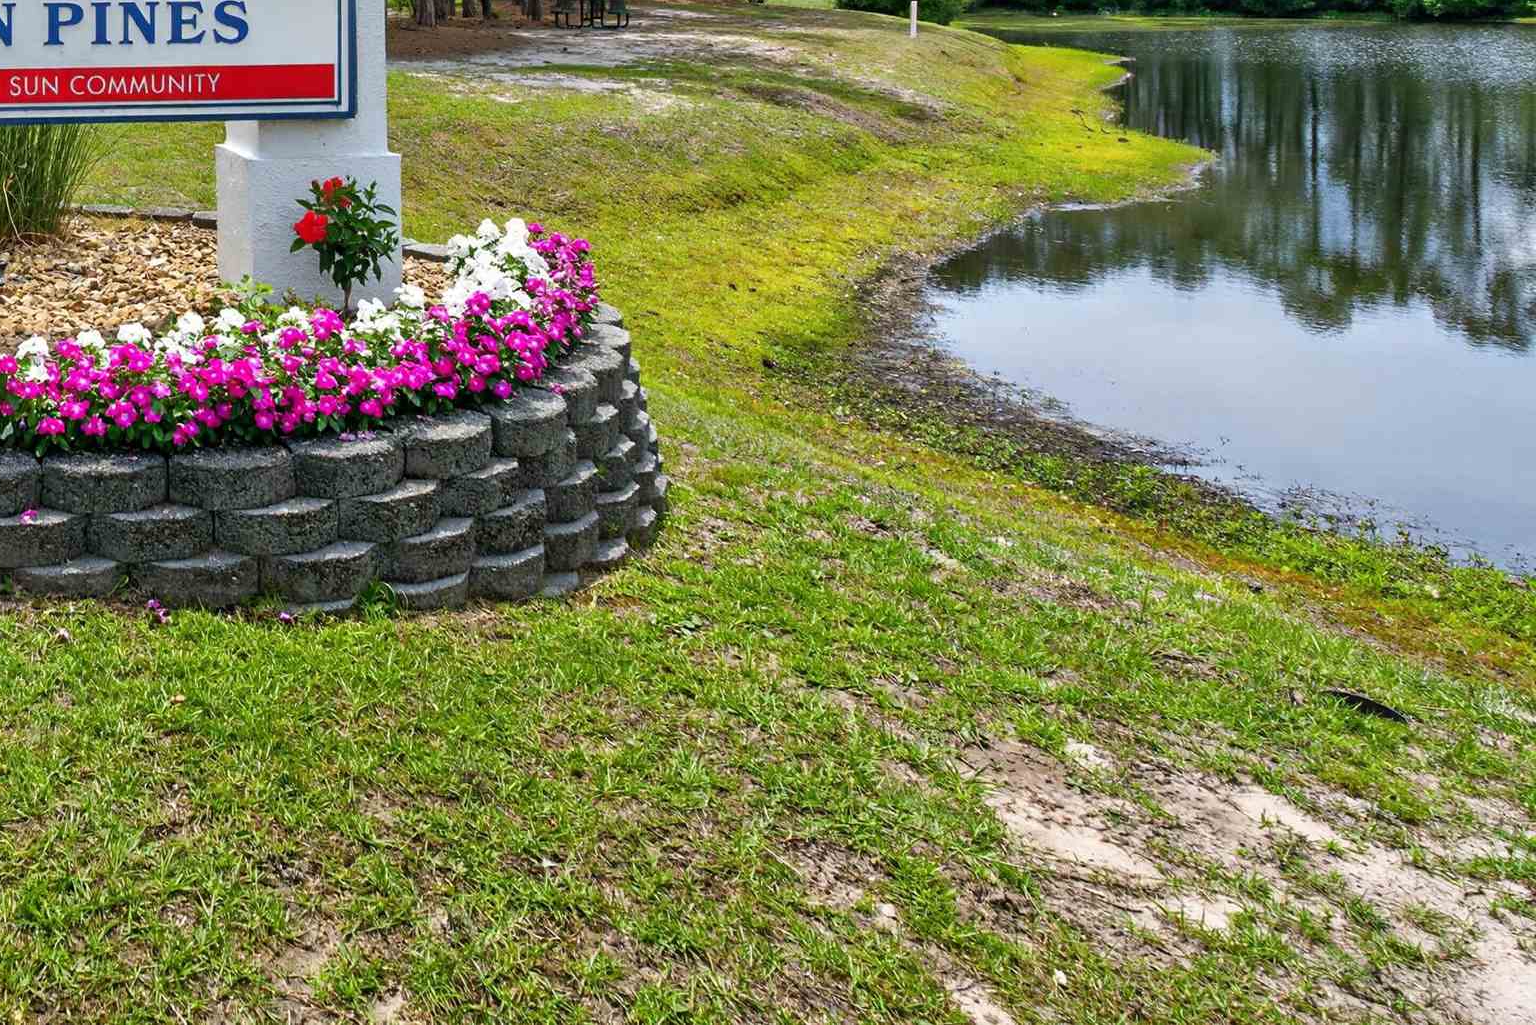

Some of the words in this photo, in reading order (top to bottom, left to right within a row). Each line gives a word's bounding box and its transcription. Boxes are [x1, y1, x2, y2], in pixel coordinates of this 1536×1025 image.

[43, 0, 250, 47] PINES
[10, 76, 60, 97] SUN
[70, 73, 220, 96] COMMUNITY
